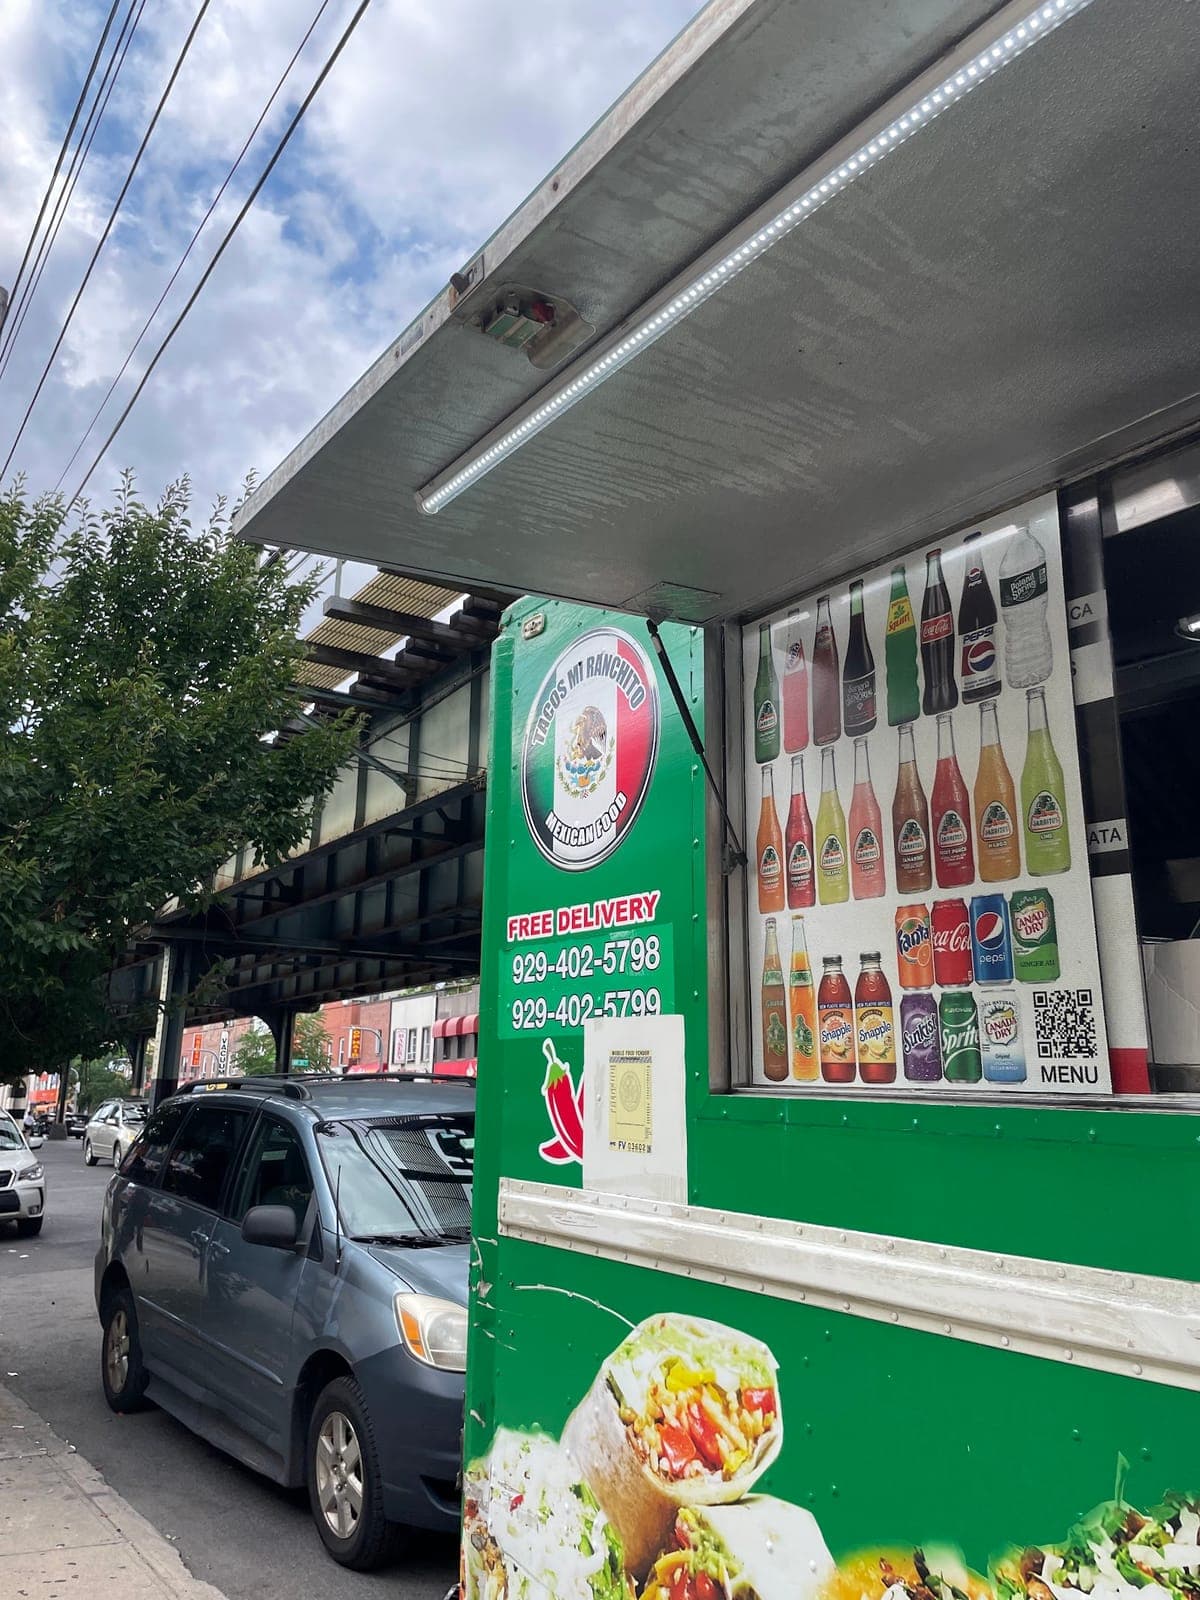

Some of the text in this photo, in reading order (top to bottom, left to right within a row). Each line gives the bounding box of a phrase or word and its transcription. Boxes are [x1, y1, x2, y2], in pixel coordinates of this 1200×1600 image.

[1011, 573, 1035, 592] Poland
[1012, 581, 1036, 601] Spring
[963, 626, 994, 644] PEPSI
[531, 652, 646, 746] TACOS MI RANCHITO
[545, 790, 628, 847] MEXICAN FOOD
[507, 890, 661, 942] FREE DELIVERY
[1015, 909, 1049, 931] CANADA
[1024, 921, 1044, 935] DRY
[897, 924, 929, 956] Fanta
[512, 935, 661, 984] 929-402-5798
[980, 952, 1006, 965] pepsi
[512, 987, 662, 1030] 929-402-5799
[822, 1022, 851, 1042] Snapple
[860, 1021, 891, 1041] Snapple
[903, 1013, 936, 1055] Sunkist
[986, 1017, 1017, 1035] CANADA
[994, 1028, 1012, 1040] DRY
[1041, 1065, 1098, 1083] MENU
